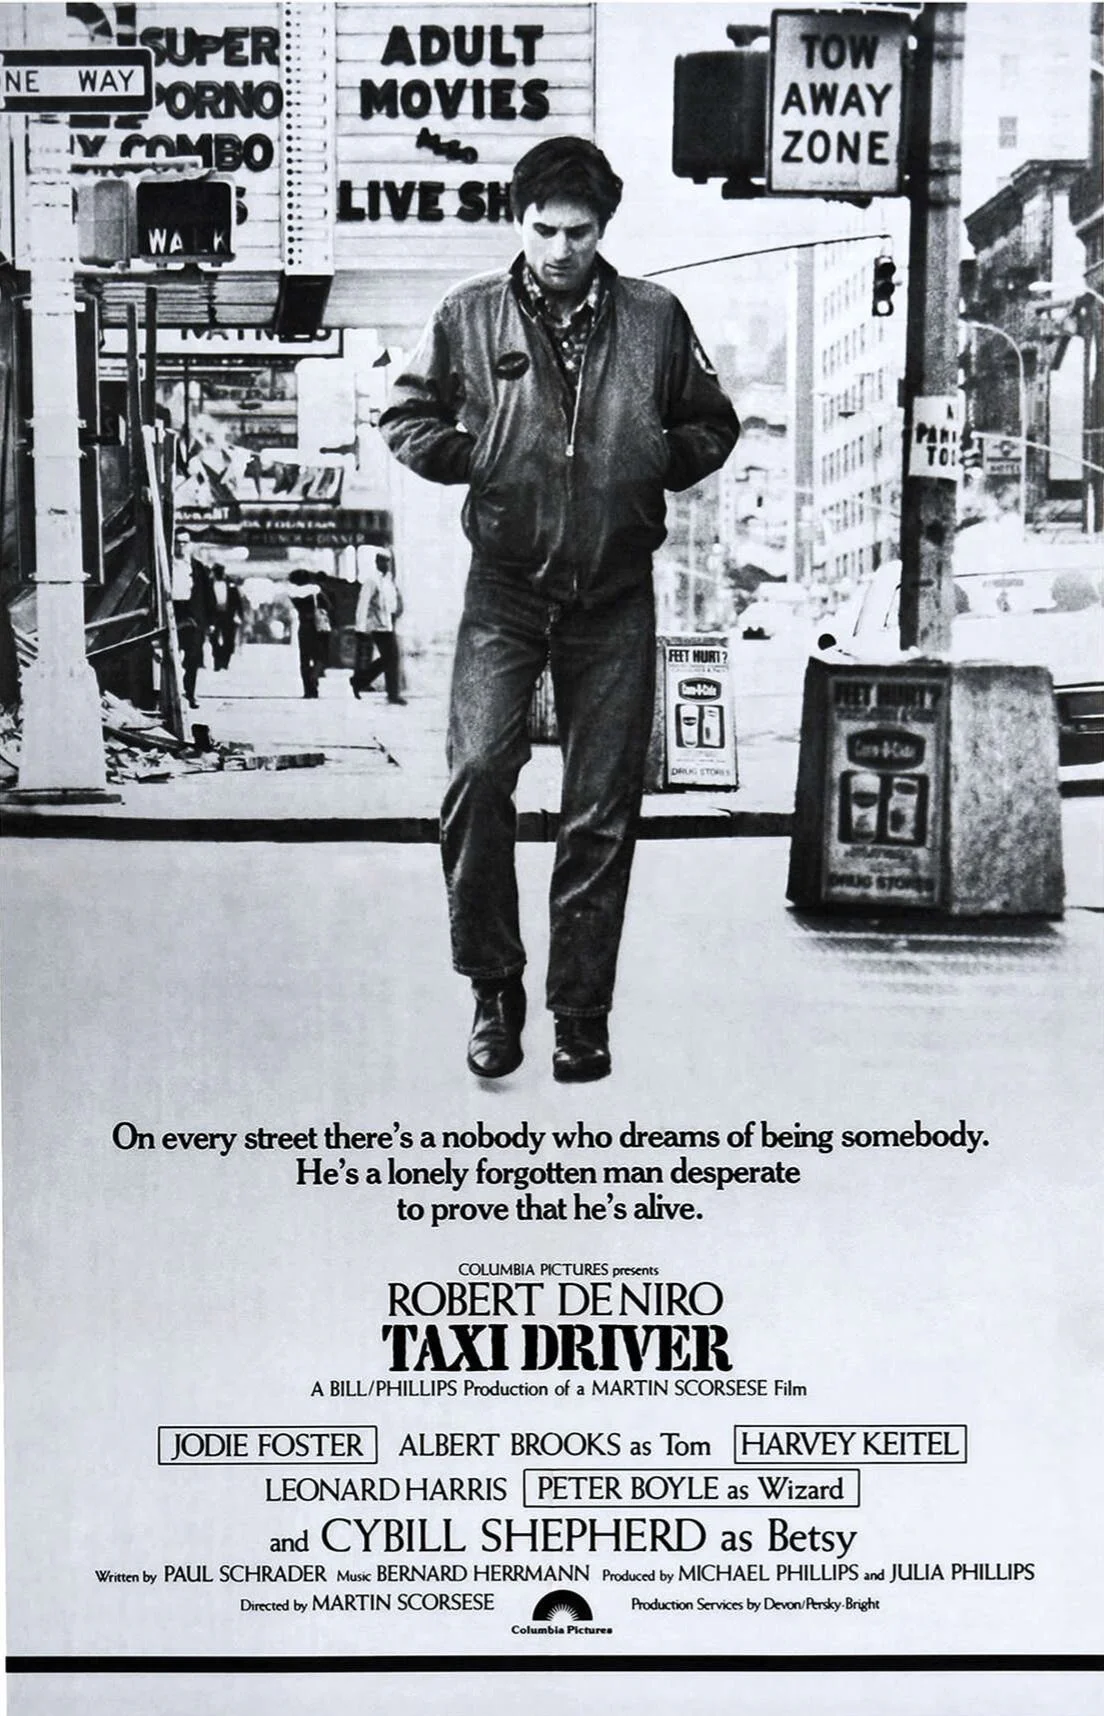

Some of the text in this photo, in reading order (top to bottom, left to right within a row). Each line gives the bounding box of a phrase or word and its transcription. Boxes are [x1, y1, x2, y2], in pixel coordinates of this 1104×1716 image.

[139, 26, 281, 67] SUPER
[380, 24, 544, 67] ADULT
[801, 34, 879, 69] TOW
[4, 69, 135, 93] NE WAY
[360, 78, 550, 120] MOVIES
[781, 83, 893, 117] AWAY
[119, 133, 274, 172] COMBO
[781, 130, 890, 165] ZONE
[338, 180, 445, 222] LIVE
[148, 227, 228, 254] WAK
[668, 649, 690, 663] FEET
[112, 1119, 990, 1157] On every street there's a nobody who dreams of being somebody.
[295, 1156, 801, 1191] He's a lonely forgotten man desperate
[396, 1192, 703, 1228] to prove that he's alive.
[458, 1262, 660, 1278] COLUMBIA PICTURES presents
[387, 1281, 545, 1317] ROBERT
[381, 1323, 734, 1372] TAXI DRIVER
[310, 1379, 807, 1397] A BILL/PHILLIPS Production of a MARTIN SCORSESE Film
[170, 1432, 364, 1461] JODIE FOSTER
[398, 1431, 711, 1457] ALBERT BROOKS as Tom
[741, 1431, 960, 1456] HARVEY KEITEL
[265, 1477, 507, 1502] LEONARD HARRIS
[538, 1475, 845, 1501] PETER BOYLE as Wizard
[269, 1517, 858, 1560] and CYBILL SHEPHERD as Betsy
[94, 1562, 1035, 1585] Written by PAUL SCHRADER Music BERNARD HERRMANN Produced by MICHAEL PHILLIPS and JULIA PHILLIPS
[240, 1592, 495, 1614] Directed by MARTIN SCORSESE
[631, 1597, 694, 1611] Production
[696, 1597, 744, 1611] Services
[746, 1597, 762, 1613] by
[511, 1625, 613, 1635] Columbia Pictures
